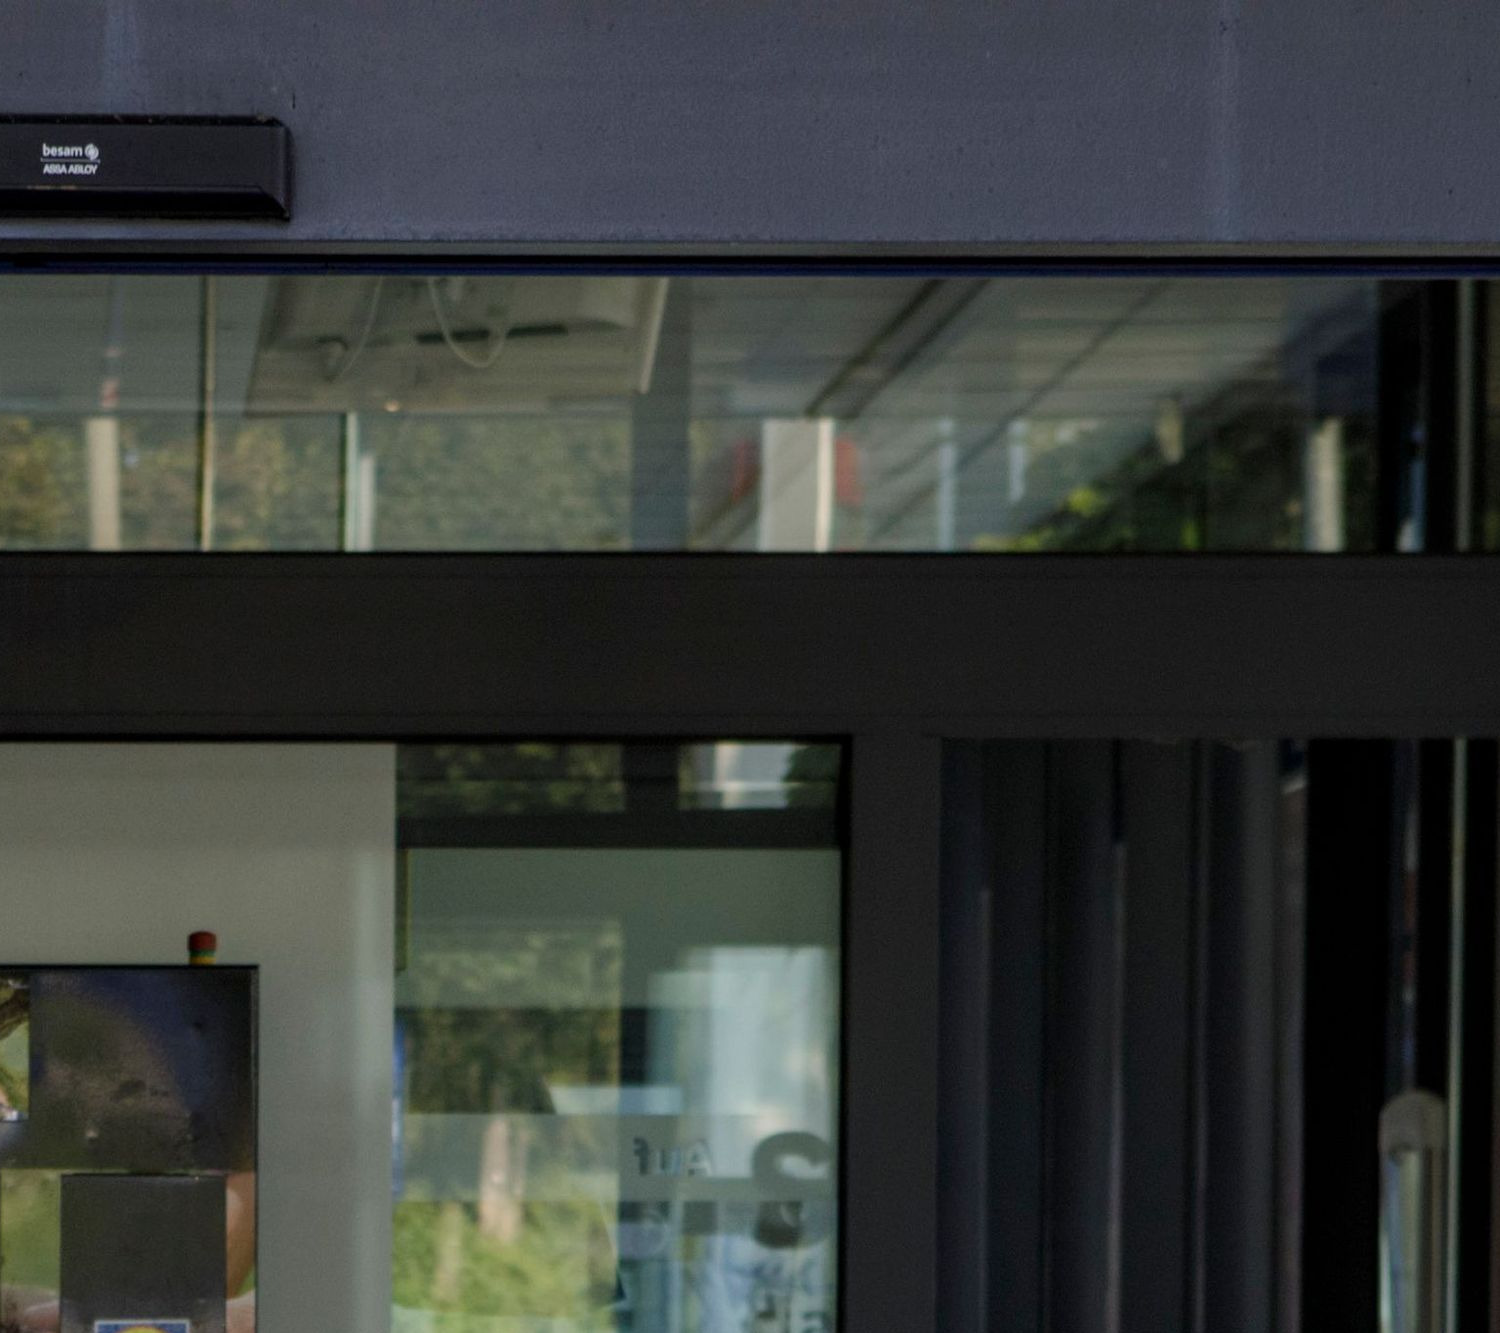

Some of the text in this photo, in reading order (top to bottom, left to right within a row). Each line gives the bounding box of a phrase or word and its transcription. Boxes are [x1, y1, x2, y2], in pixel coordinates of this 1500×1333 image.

[42, 143, 83, 158] besam
[43, 164, 98, 175] ASSA ABLOY
